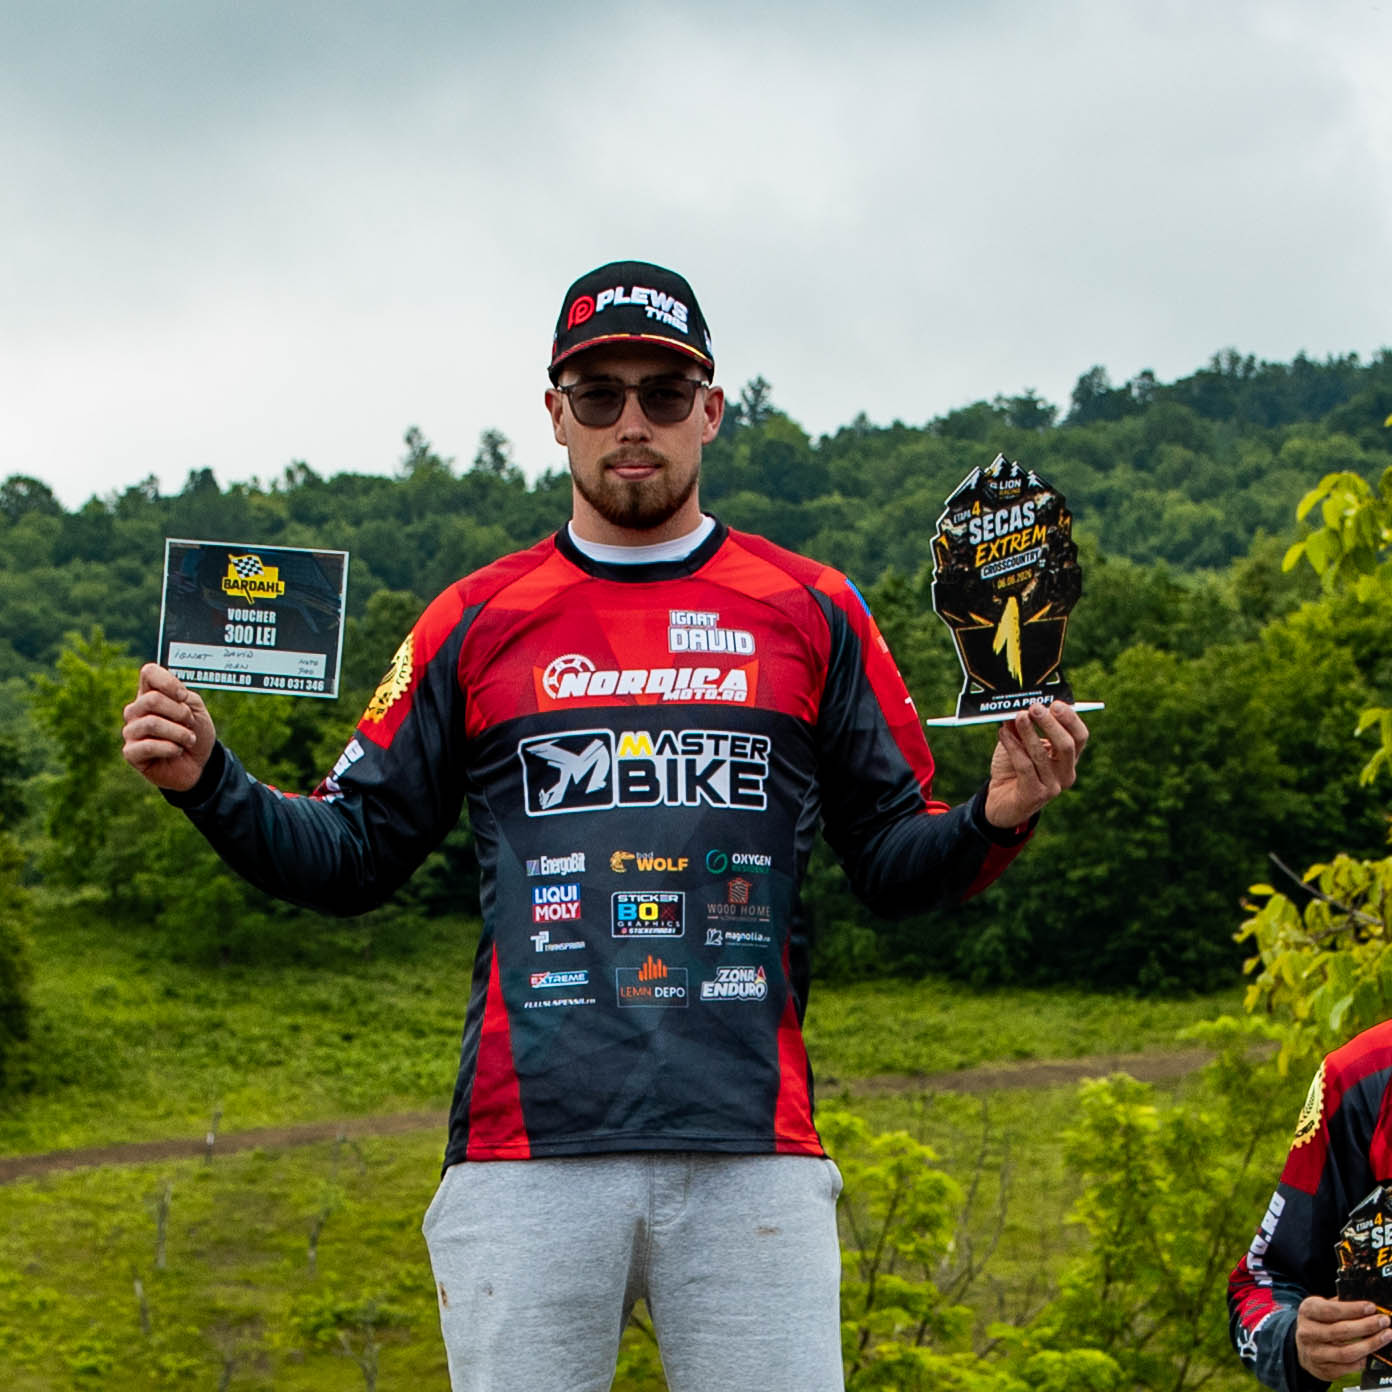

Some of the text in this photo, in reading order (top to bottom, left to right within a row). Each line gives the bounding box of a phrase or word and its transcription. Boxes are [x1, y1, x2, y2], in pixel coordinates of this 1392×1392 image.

[595, 285, 689, 325] PLEWS
[999, 479, 1022, 490] LION
[971, 500, 982, 516] 4
[969, 501, 1035, 545] SECAS
[975, 524, 1047, 568] EXTREM
[983, 549, 1041, 577] CROSSCOUNTRY
[223, 578, 284, 594] BARDAHL
[227, 607, 276, 624] VOUCHER
[670, 610, 719, 627] IGNAT
[224, 624, 276, 646] 300 LEI
[669, 627, 755, 655] DAVID
[992, 595, 1023, 689] 1
[172, 668, 252, 686] WW.BARDHAL.RO
[286, 678, 305, 689] 031
[557, 668, 747, 699] NORDICA
[662, 688, 747, 702] MOTO.RO
[979, 700, 1011, 712] MOTO
[1013, 698, 1021, 708] A
[617, 733, 770, 759] MASTER
[617, 758, 766, 808] BIKE
[636, 857, 689, 872] WOLF
[731, 853, 772, 867] OXYGEN
[534, 884, 578, 904] LIQUI
[617, 893, 679, 903] STICKER
[534, 902, 580, 922] MOLY
[617, 902, 678, 921] BOX
[530, 973, 586, 986] EXTREME
[654, 986, 686, 999] DEPO
[702, 982, 766, 998] ENDURO
[1374, 1212, 1384, 1225] 4
